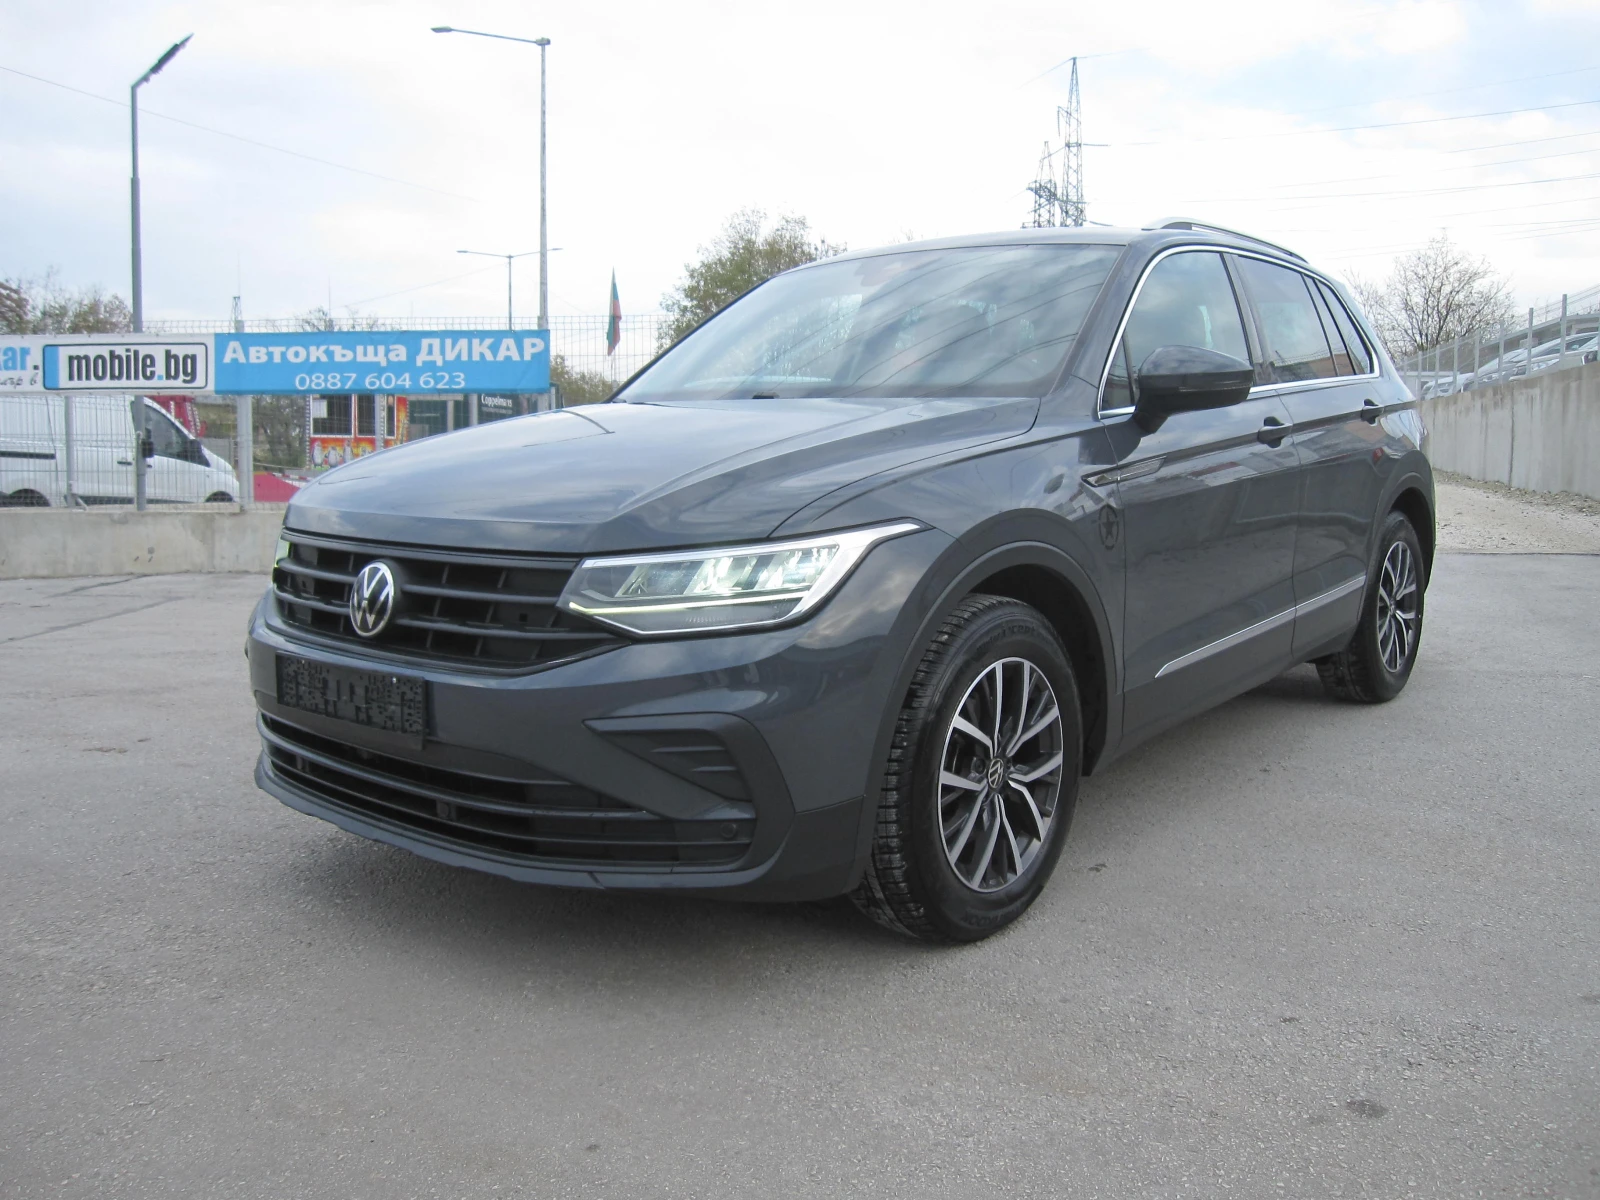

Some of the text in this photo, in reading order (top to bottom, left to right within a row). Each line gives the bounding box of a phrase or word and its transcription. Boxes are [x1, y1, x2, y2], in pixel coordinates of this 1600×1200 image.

[68, 348, 198, 384] mobile.bg
[223, 338, 545, 367] Автокъща ДИКАР
[295, 372, 466, 390] 0887 604 623
